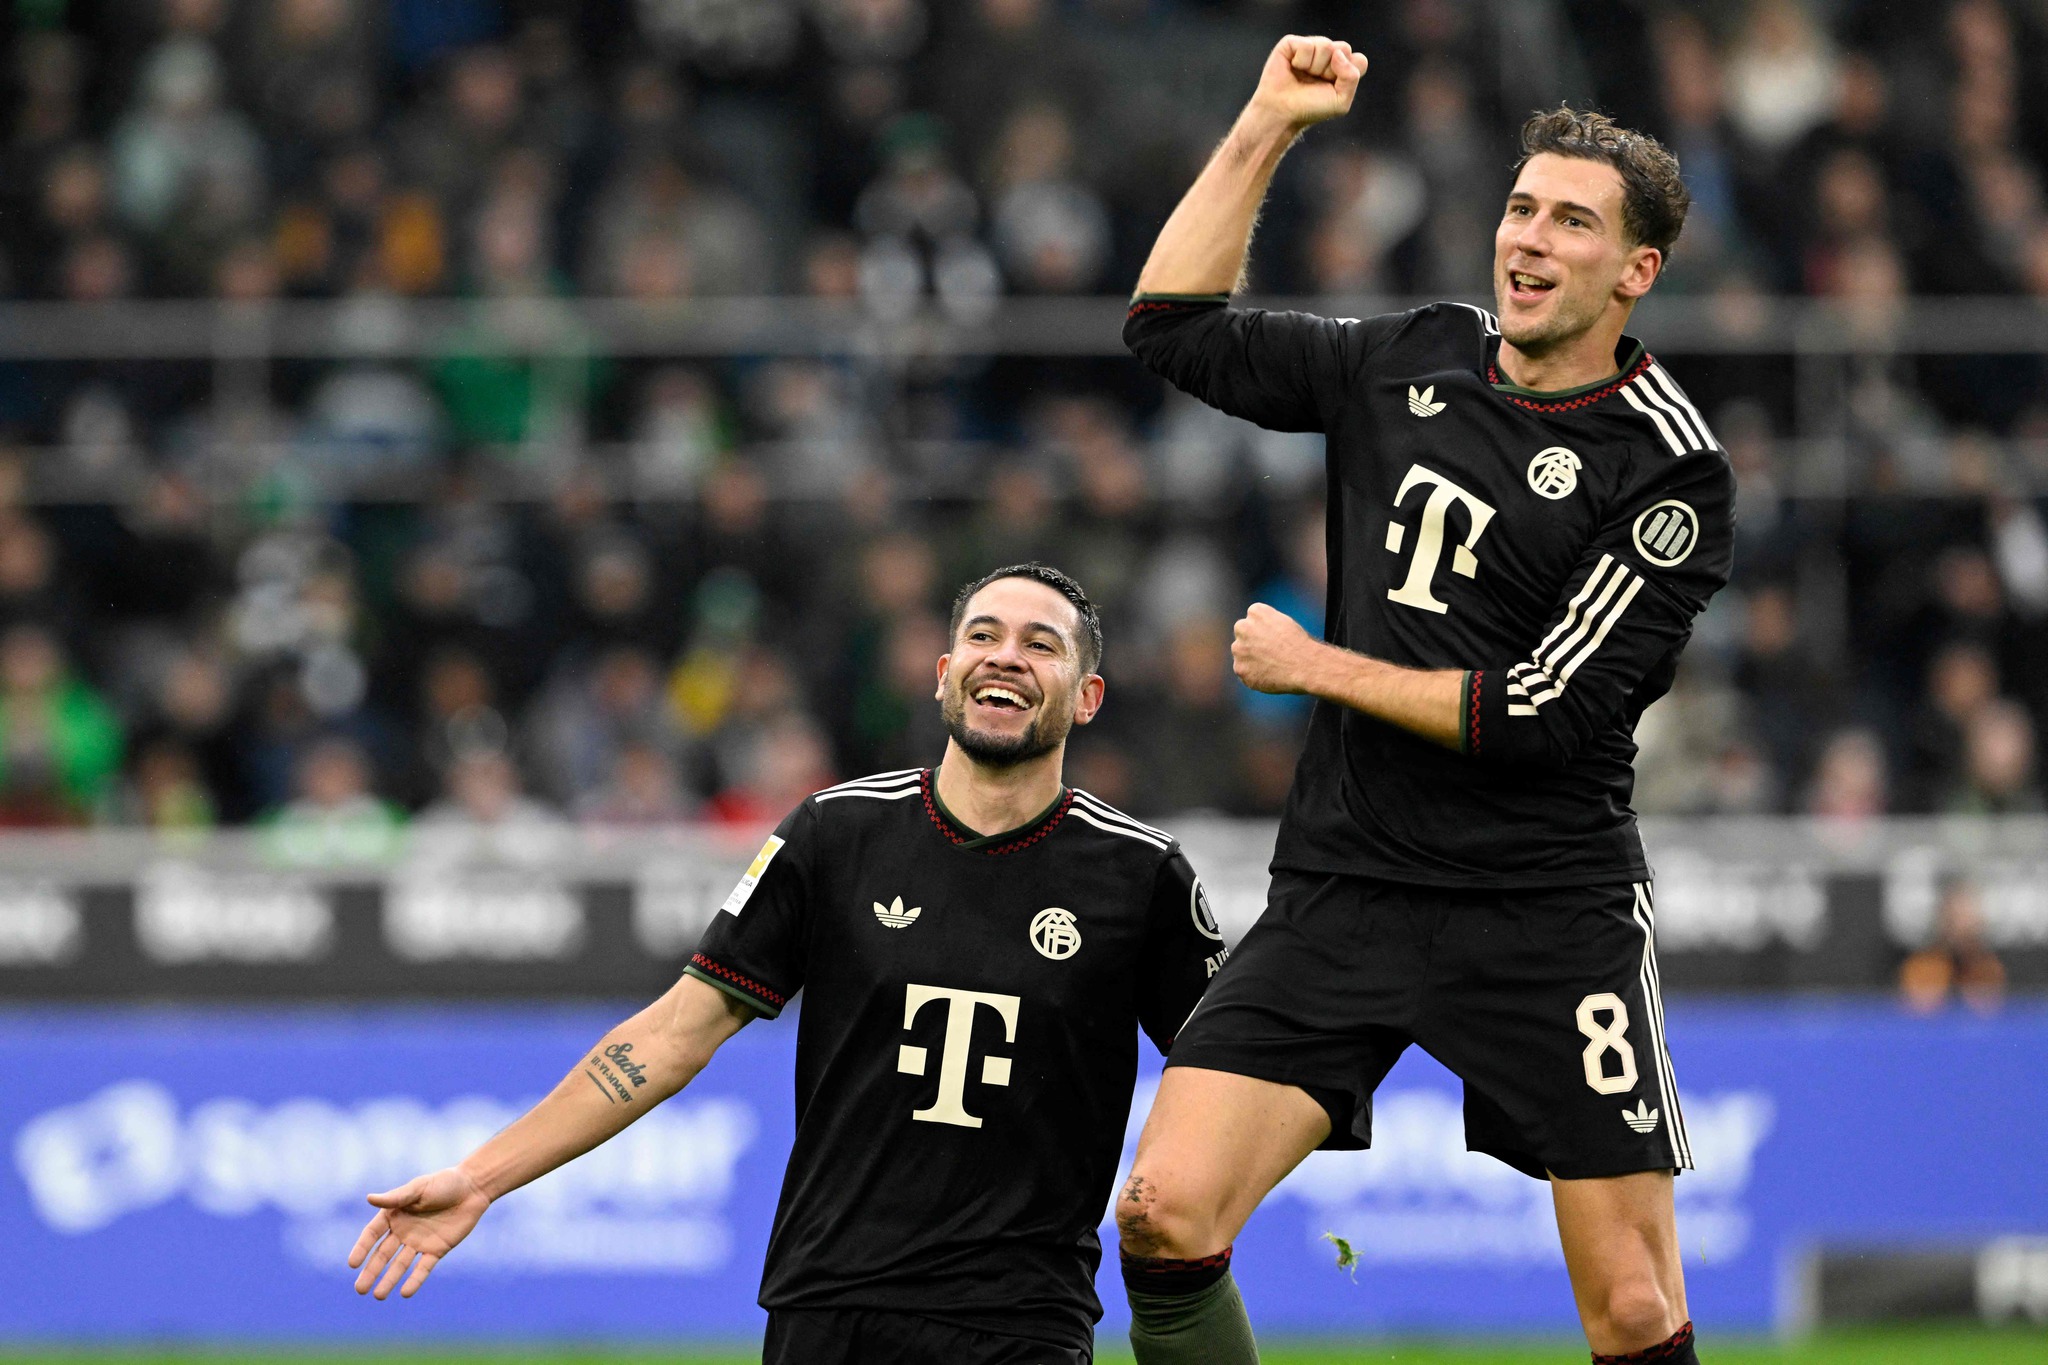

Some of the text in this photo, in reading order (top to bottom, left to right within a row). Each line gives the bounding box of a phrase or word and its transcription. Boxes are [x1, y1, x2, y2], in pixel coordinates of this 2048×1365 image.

[1385, 464, 1497, 615] T
[604, 1043, 647, 1088] Sacha
[897, 983, 1021, 1129] T
[1576, 992, 1639, 1095] 8
